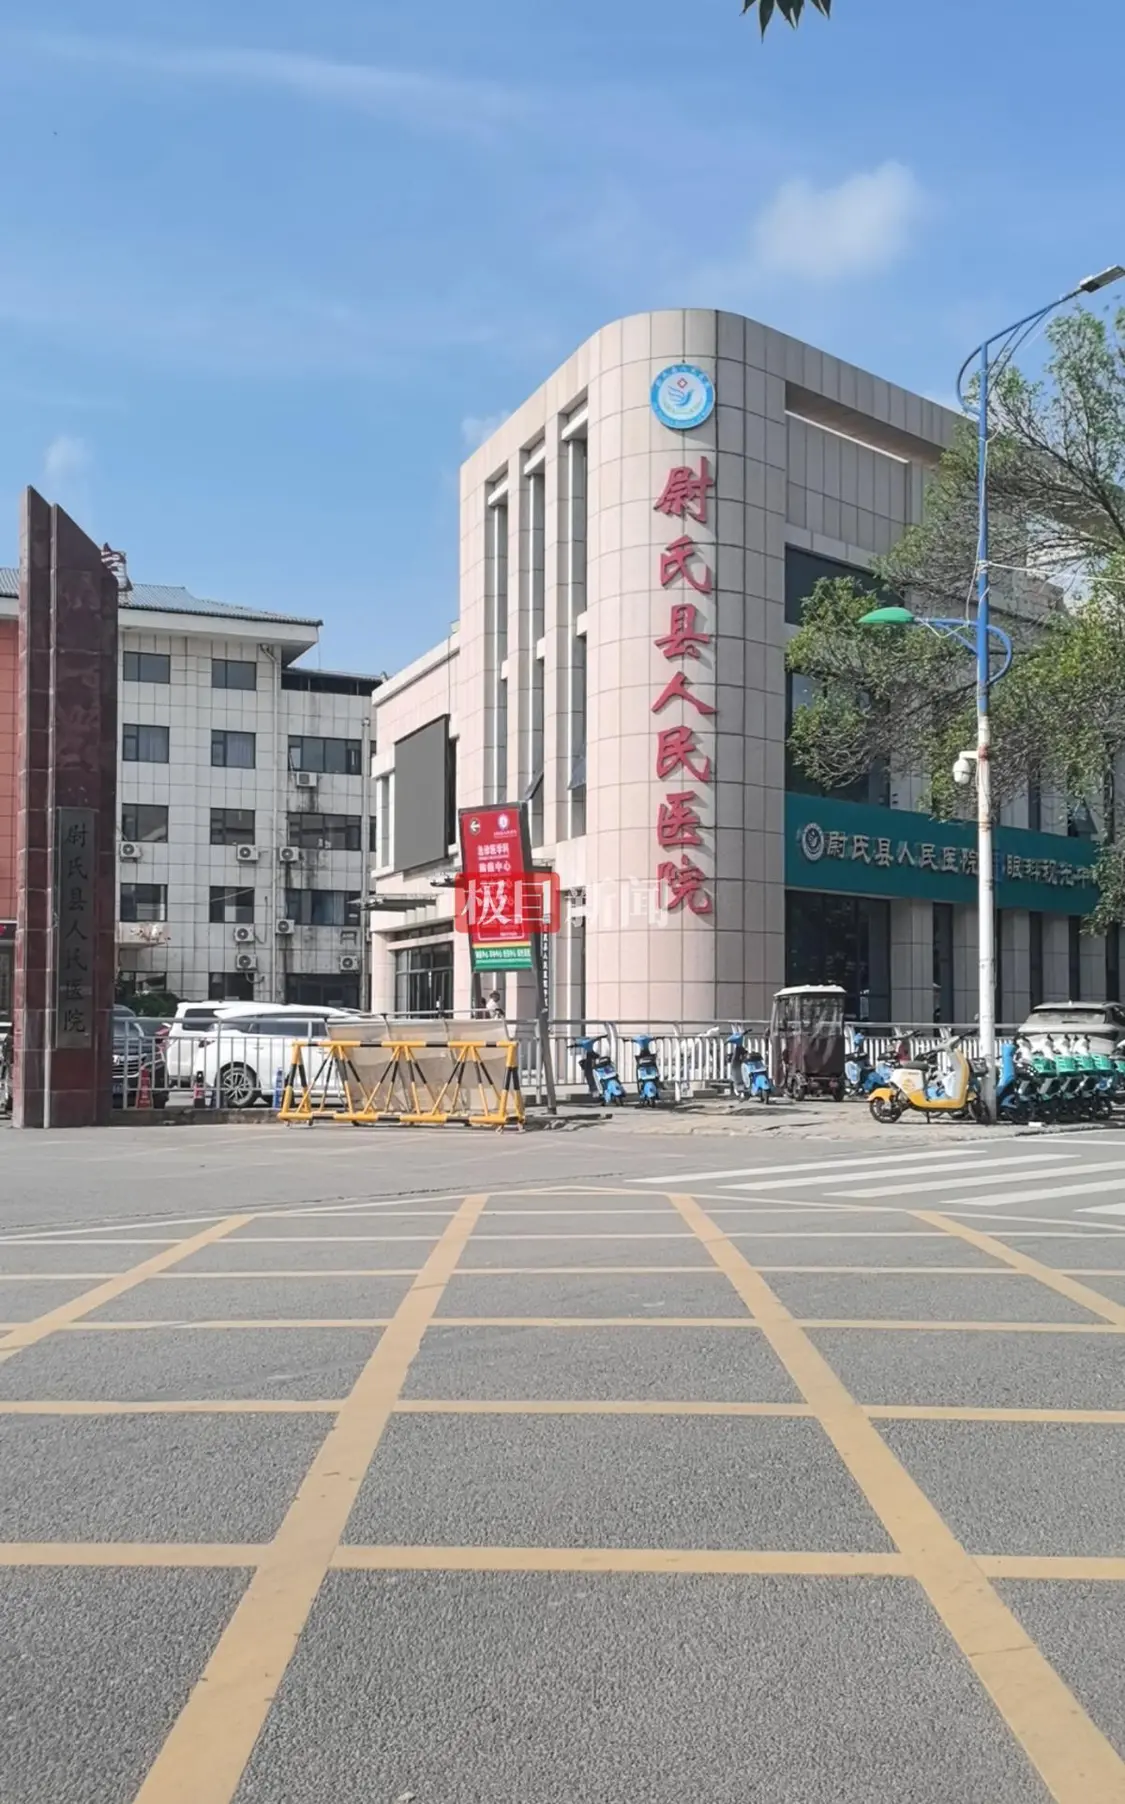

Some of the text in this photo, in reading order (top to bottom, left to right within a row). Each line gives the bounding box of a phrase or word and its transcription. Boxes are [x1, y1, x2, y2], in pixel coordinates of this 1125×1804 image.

[652, 456, 716, 916] 尉氏县人民医院
[63, 822, 89, 1034] 尉氏县人民医院
[825, 830, 979, 876] 尉氏县人民医院
